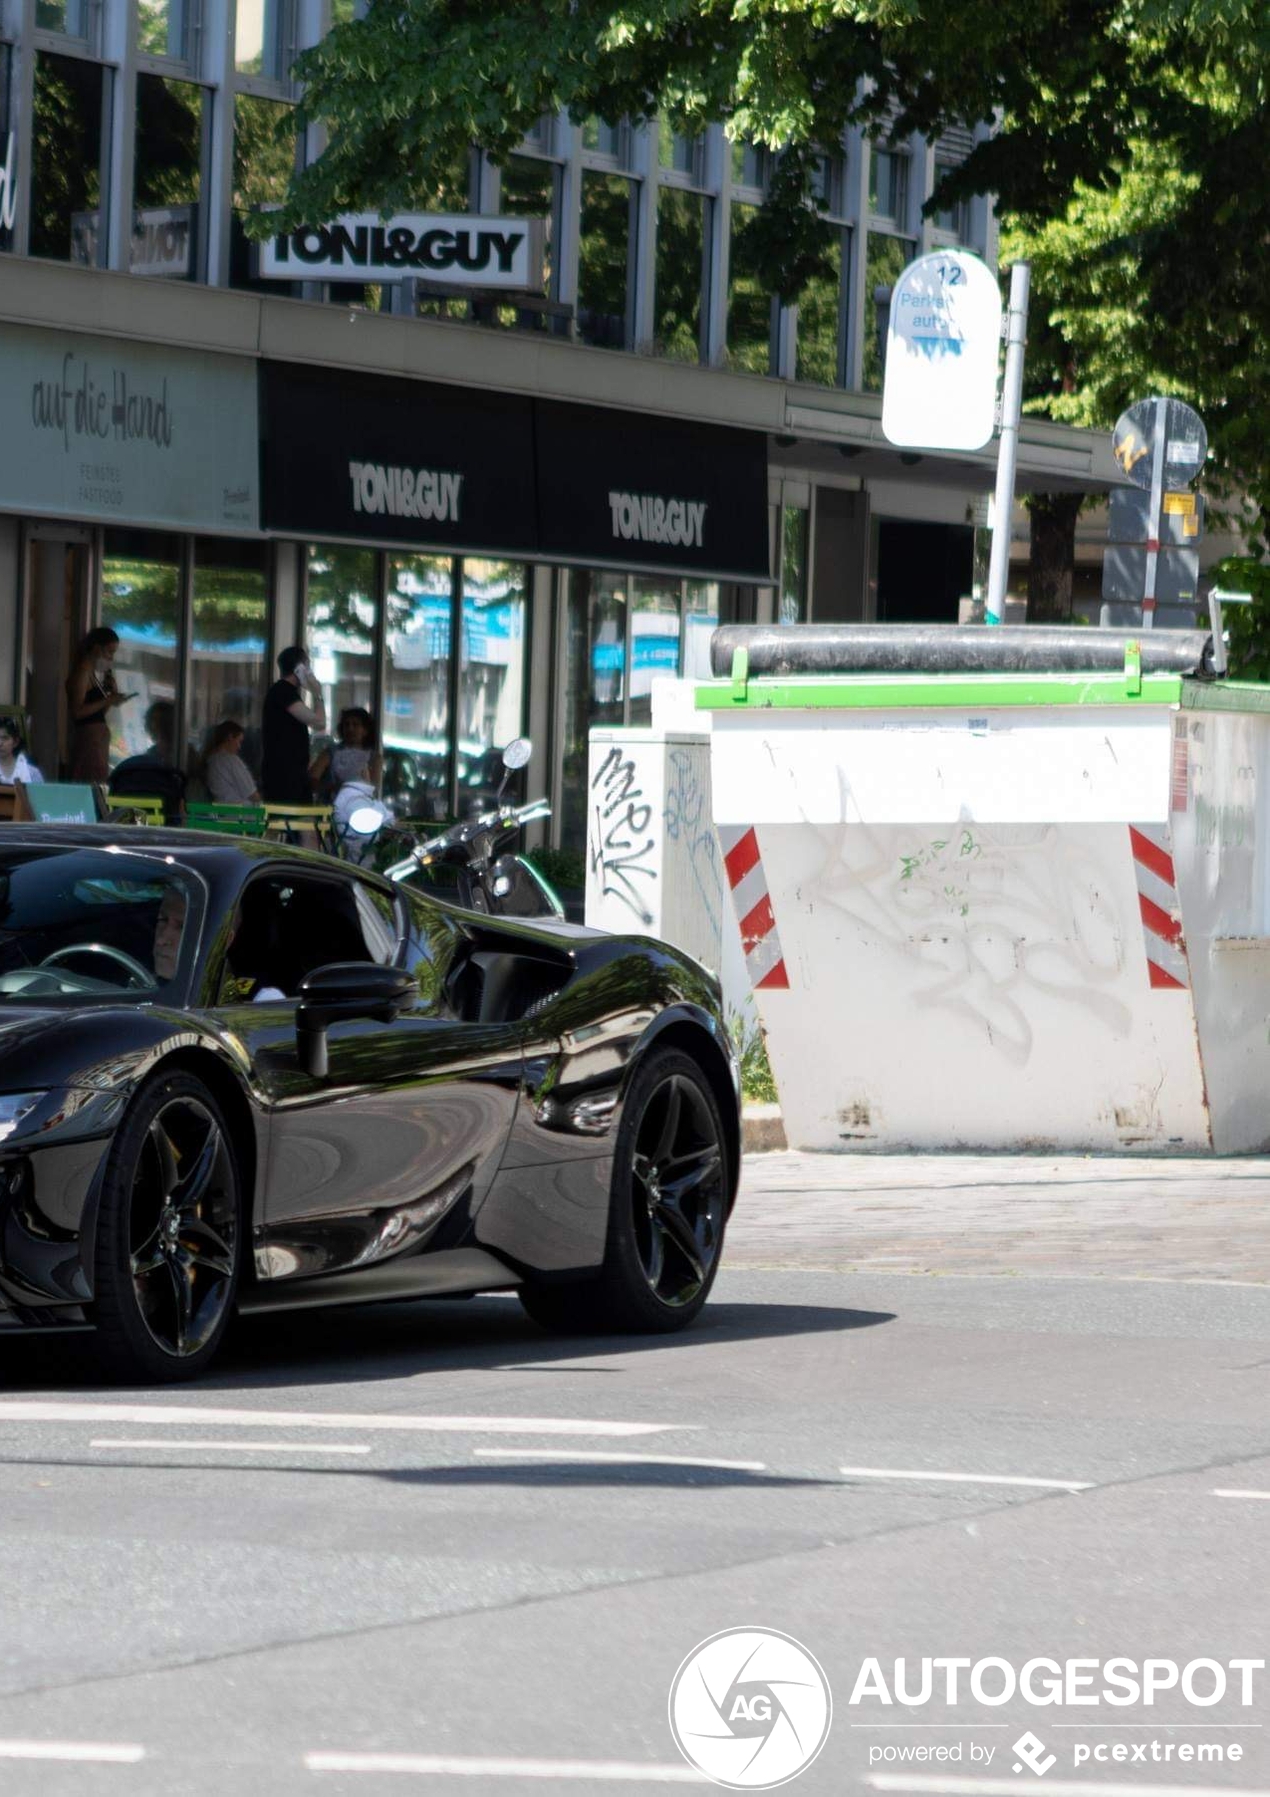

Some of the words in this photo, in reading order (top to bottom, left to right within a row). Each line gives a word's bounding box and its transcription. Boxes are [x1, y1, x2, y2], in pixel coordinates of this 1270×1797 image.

[937, 265, 962, 286] 12
[32, 352, 76, 453] auf
[75, 361, 110, 439] die
[112, 367, 172, 449] Hand
[348, 461, 463, 522] TONI&GUY
[609, 492, 706, 547] TONI&GUY
